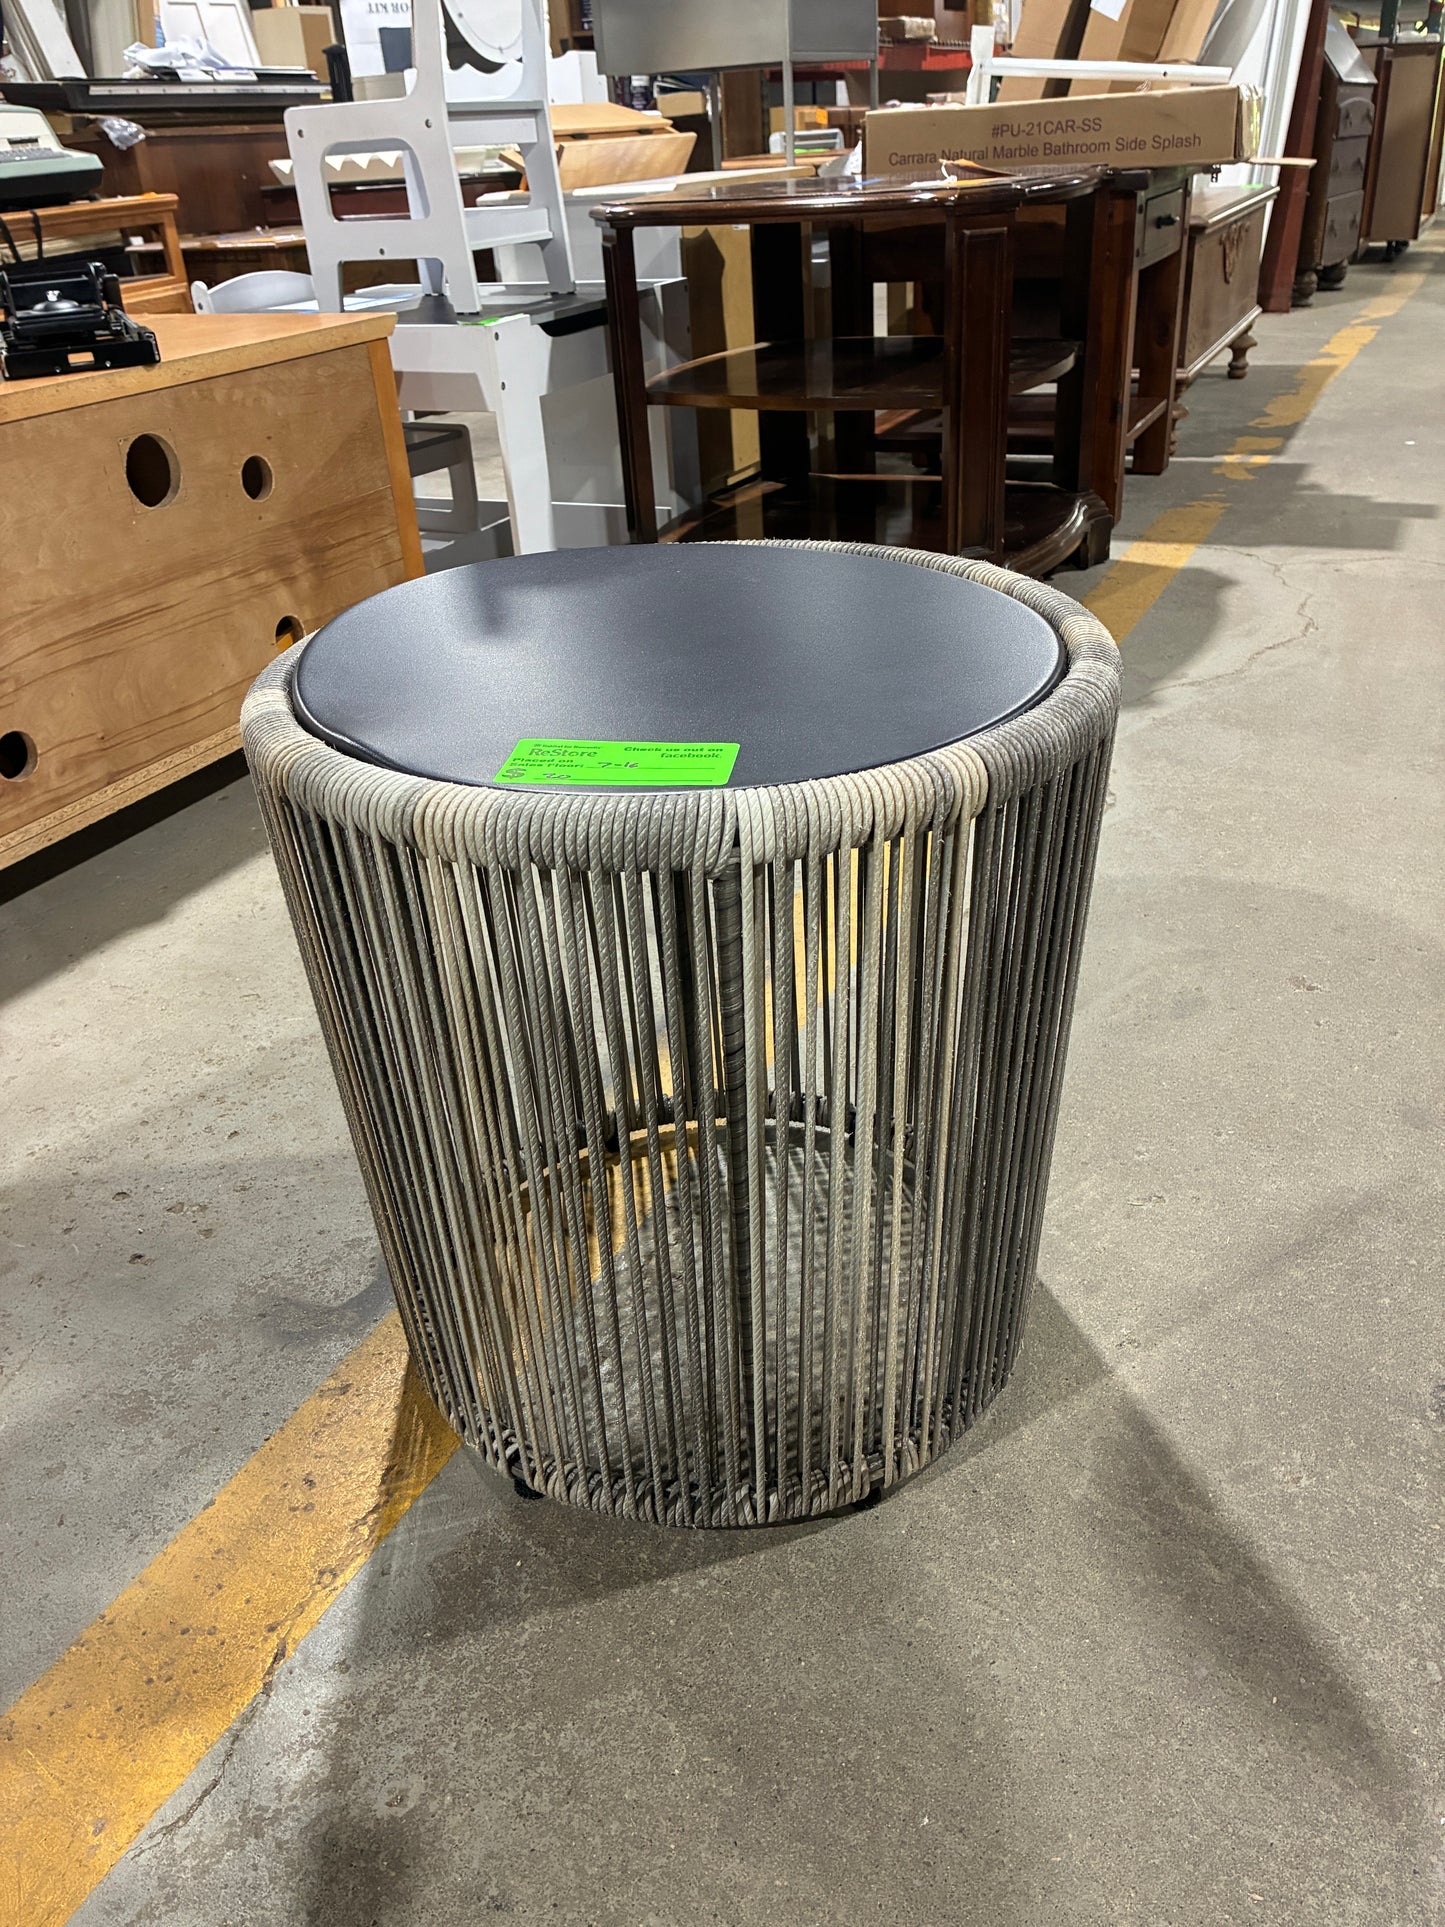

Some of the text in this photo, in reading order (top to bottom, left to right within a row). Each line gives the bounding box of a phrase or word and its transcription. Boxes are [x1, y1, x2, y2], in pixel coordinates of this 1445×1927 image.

[992, 117, 1102, 139] #PU-21CAR-SS
[888, 133, 1202, 166] Carrara Natural Marble Bathroom Side Splash
[528, 748, 598, 758] ReStore
